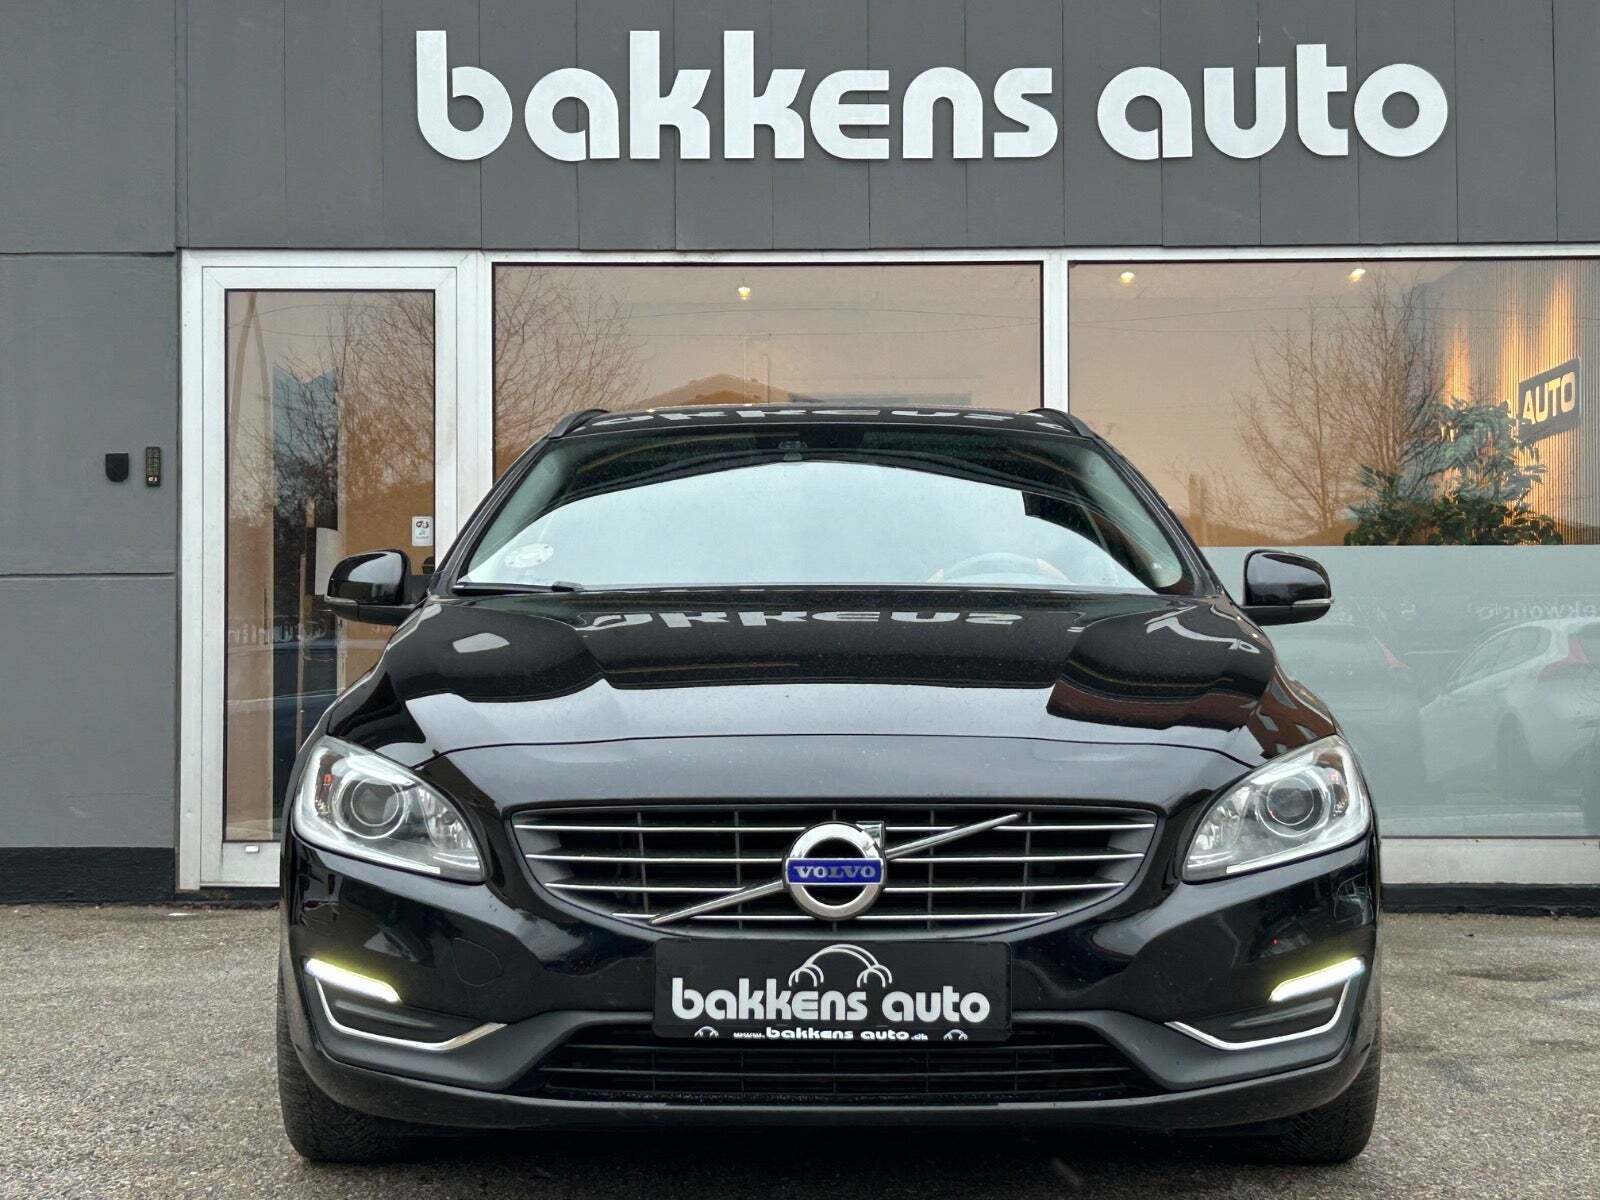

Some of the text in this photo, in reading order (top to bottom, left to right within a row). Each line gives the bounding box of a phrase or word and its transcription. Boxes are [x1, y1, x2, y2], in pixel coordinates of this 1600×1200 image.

[416, 30, 1448, 161] bakkens auto
[1523, 371, 1576, 424] AUTO
[793, 865, 876, 879] VOLVO
[672, 977, 990, 1023] bakkens auto
